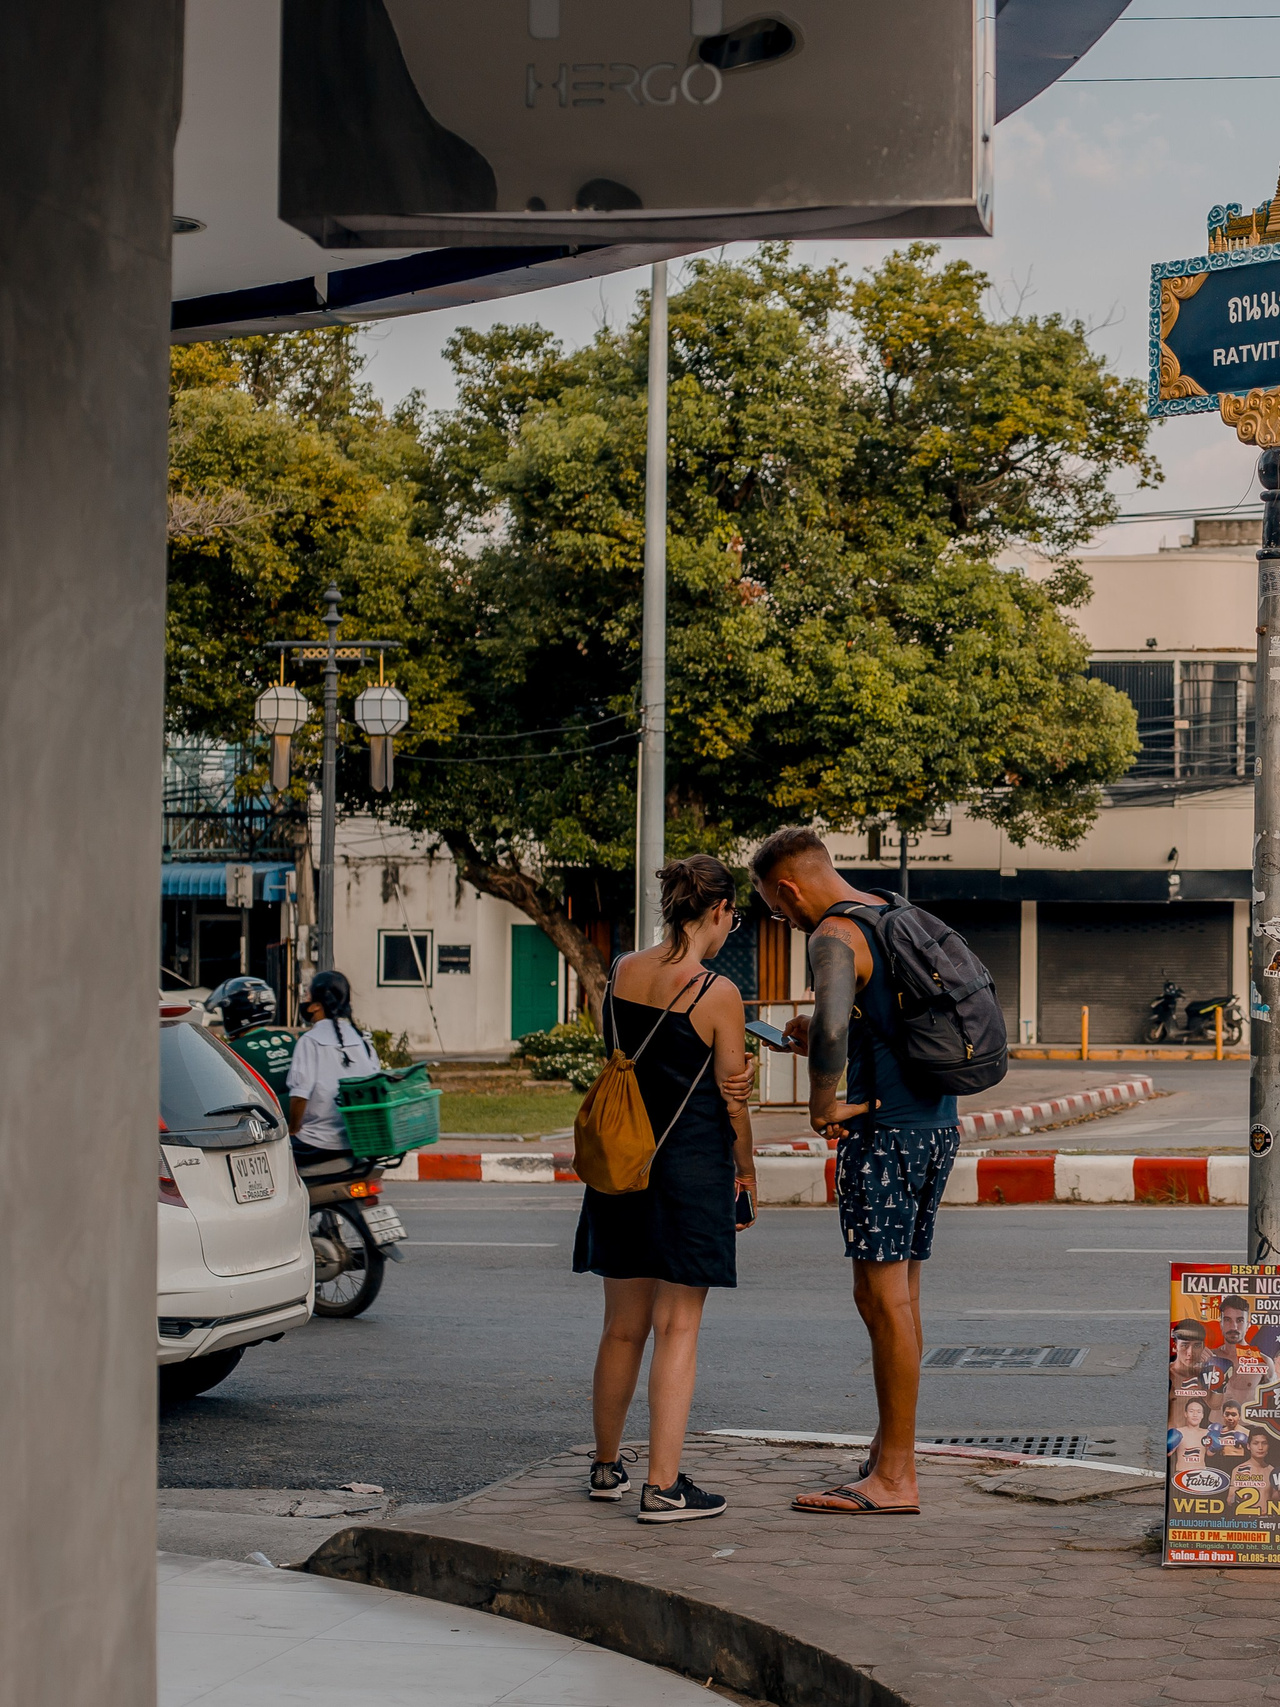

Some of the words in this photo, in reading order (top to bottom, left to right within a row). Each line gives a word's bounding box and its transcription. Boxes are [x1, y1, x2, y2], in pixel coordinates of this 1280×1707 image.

[525, 62, 722, 108] HERGO
[173, 1158, 201, 1169] JAZZ
[249, 1156, 269, 1176] 5172
[1231, 1265, 1260, 1275] BEST
[1187, 1277, 1249, 1294] KALARE
[1238, 1366, 1268, 1374] ALEXY
[1203, 1371, 1220, 1385] VS
[1185, 1472, 1221, 1488] Fairtex
[1173, 1498, 1224, 1513] WED
[1235, 1487, 1261, 1516] 2
[1259, 1520, 1276, 1530] Every
[1171, 1530, 1197, 1540] START
[1199, 1531, 1205, 1540] 9
[1195, 1542, 1225, 1550] Ringside
